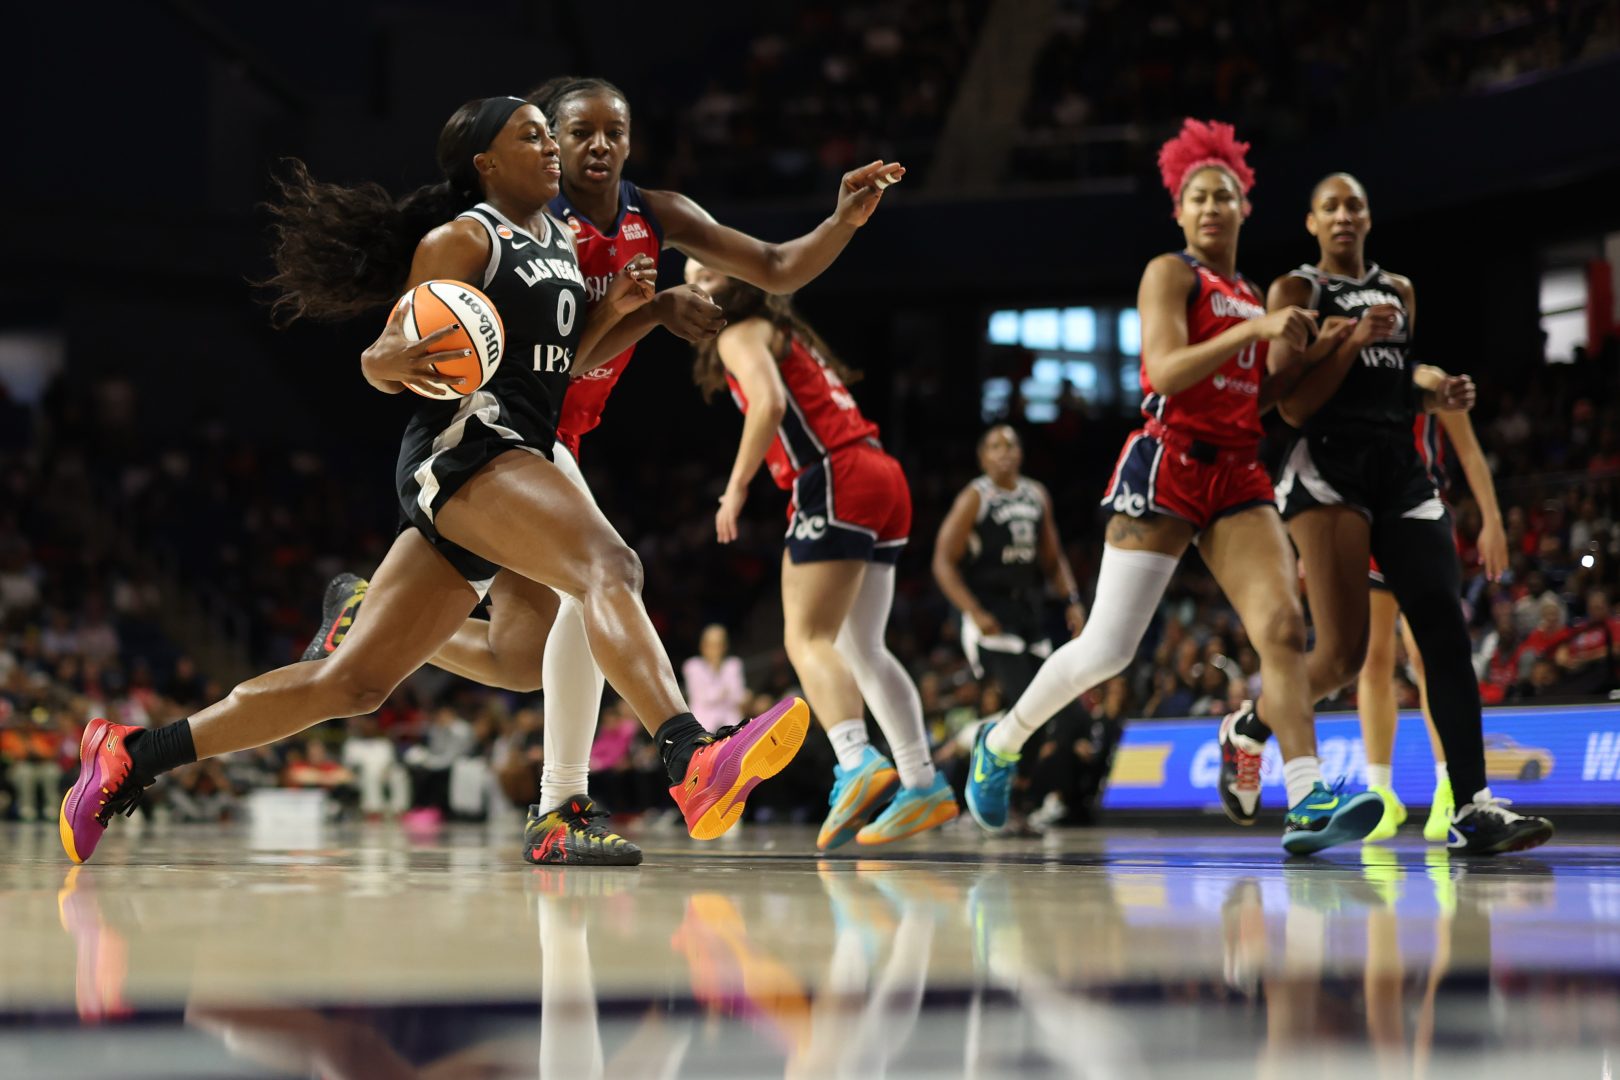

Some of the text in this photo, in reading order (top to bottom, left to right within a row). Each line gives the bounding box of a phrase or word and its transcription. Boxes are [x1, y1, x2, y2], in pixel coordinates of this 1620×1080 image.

[621, 223, 641, 232] CAR
[624, 229, 649, 241] max
[514, 258, 553, 288] LAS
[545, 258, 586, 292] VEGA
[557, 288, 576, 337] 0
[459, 292, 500, 367] Wilson
[533, 344, 573, 374] IPS
